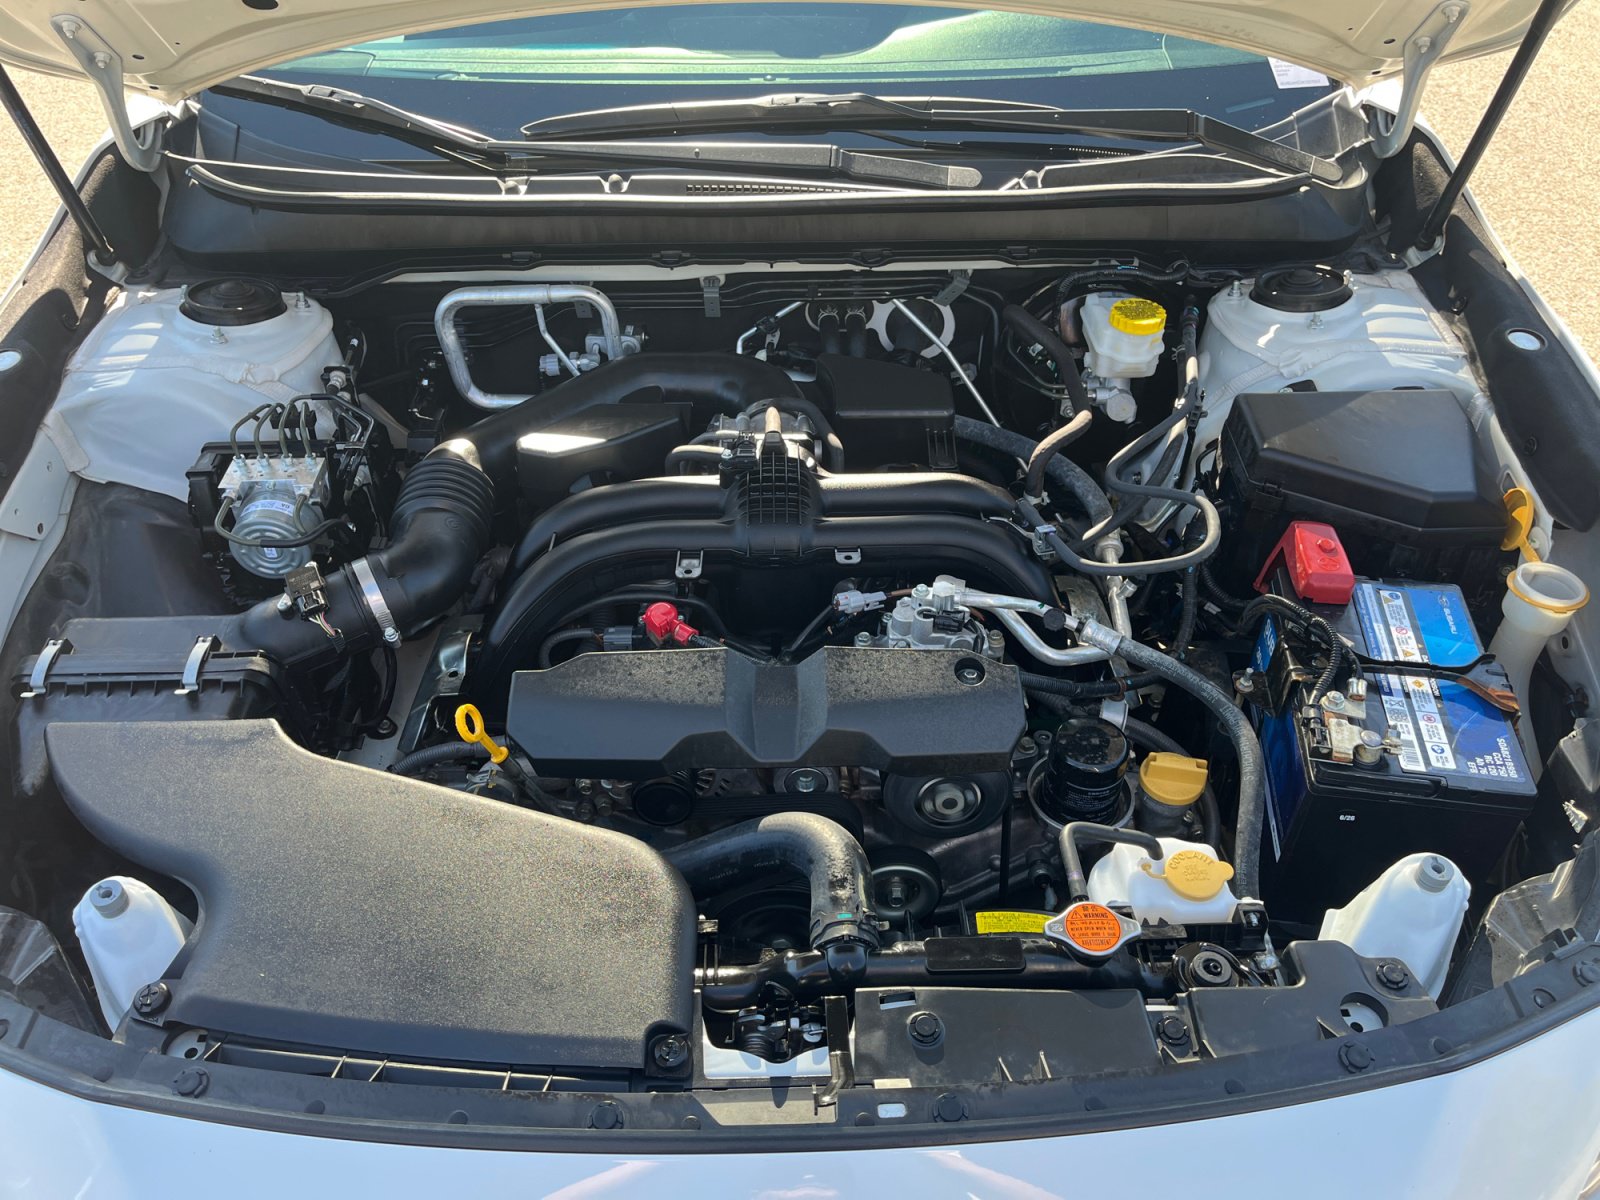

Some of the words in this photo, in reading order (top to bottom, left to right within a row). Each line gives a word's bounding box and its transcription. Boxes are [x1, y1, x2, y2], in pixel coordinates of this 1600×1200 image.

[1444, 608, 1458, 634] SUBARU
[1484, 754, 1494, 765] RC
[1492, 752, 1504, 765] CCA
[1487, 765, 1499, 776] 120
[1497, 766, 1508, 777] 750
[1169, 851, 1214, 870] COOLANT
